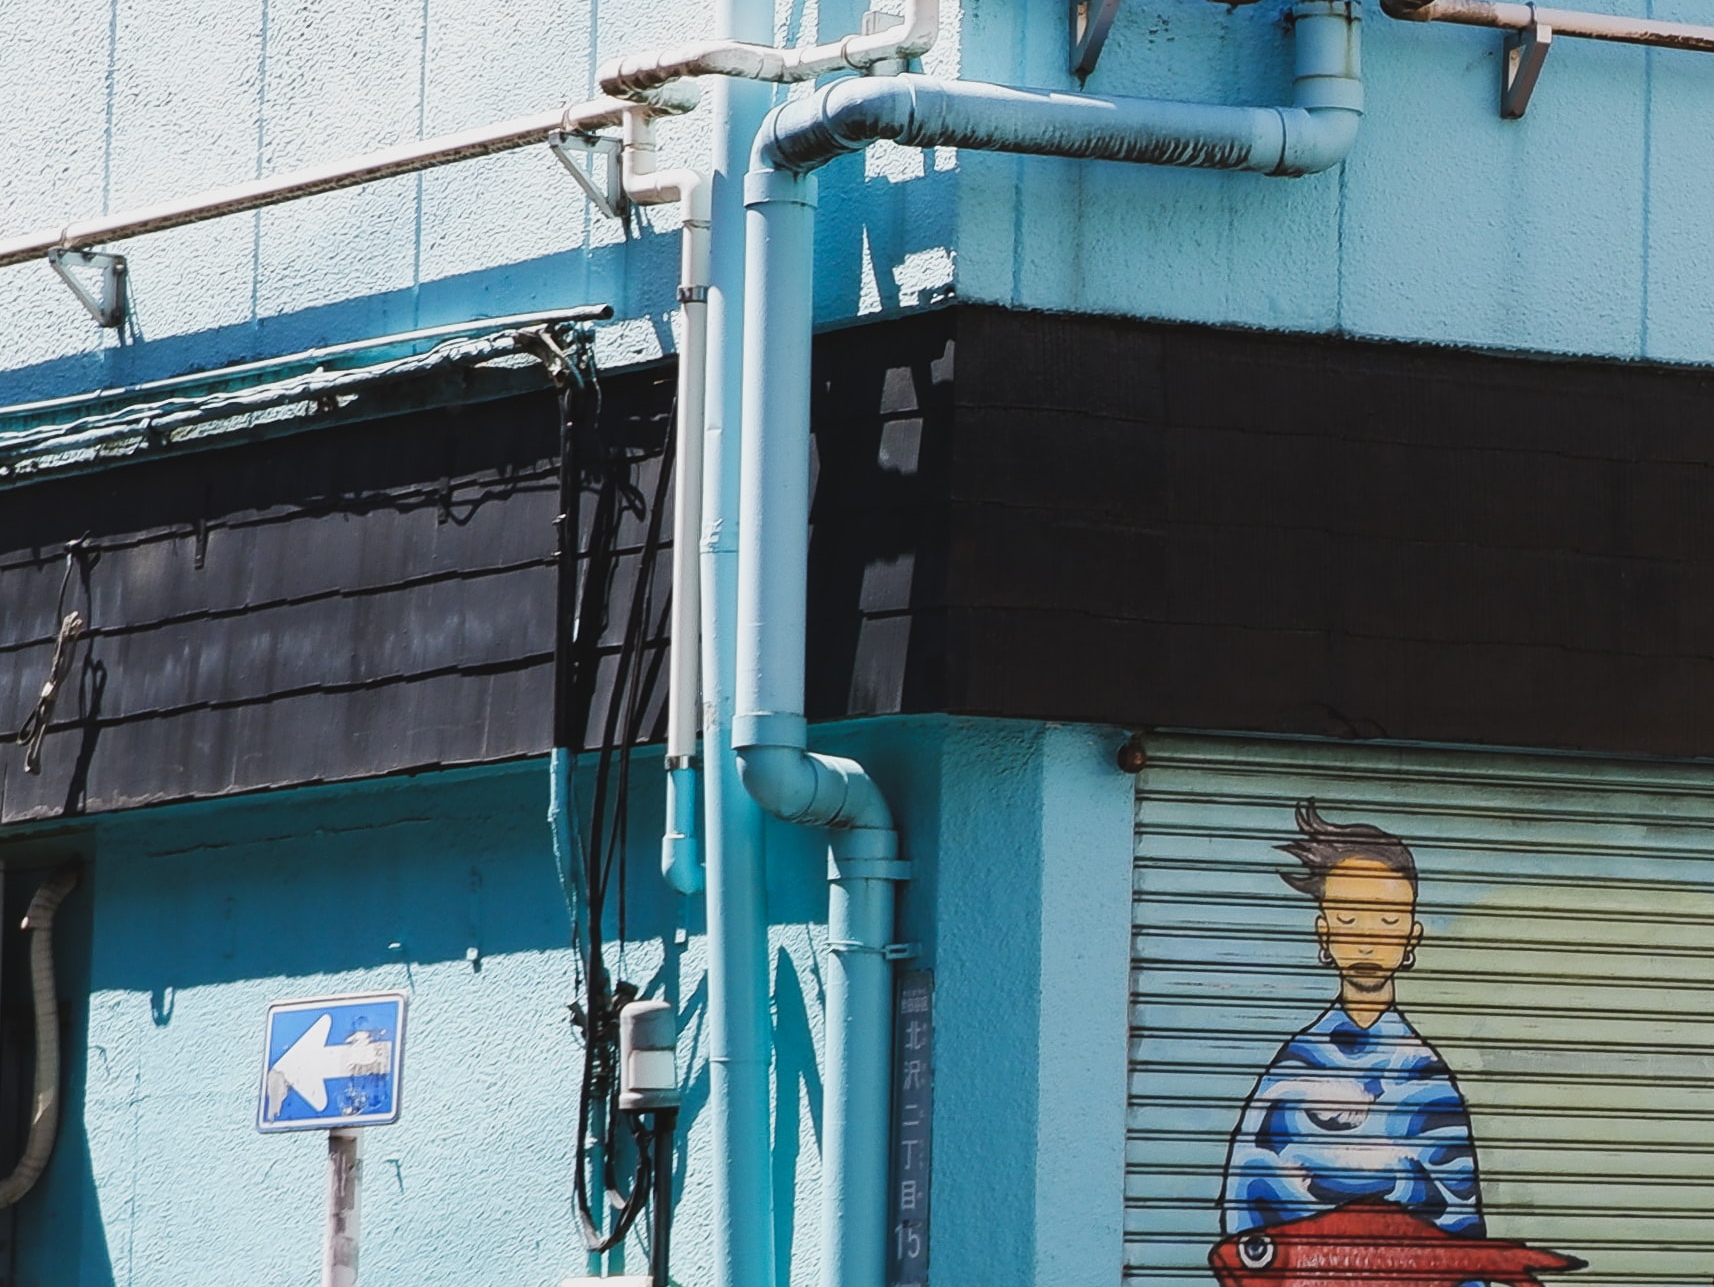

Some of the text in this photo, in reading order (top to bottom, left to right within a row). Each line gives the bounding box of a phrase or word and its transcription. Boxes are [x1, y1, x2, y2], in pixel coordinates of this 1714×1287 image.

[901, 1020, 922, 1210] 北沢二丁目
[894, 1221, 922, 1259] 15
